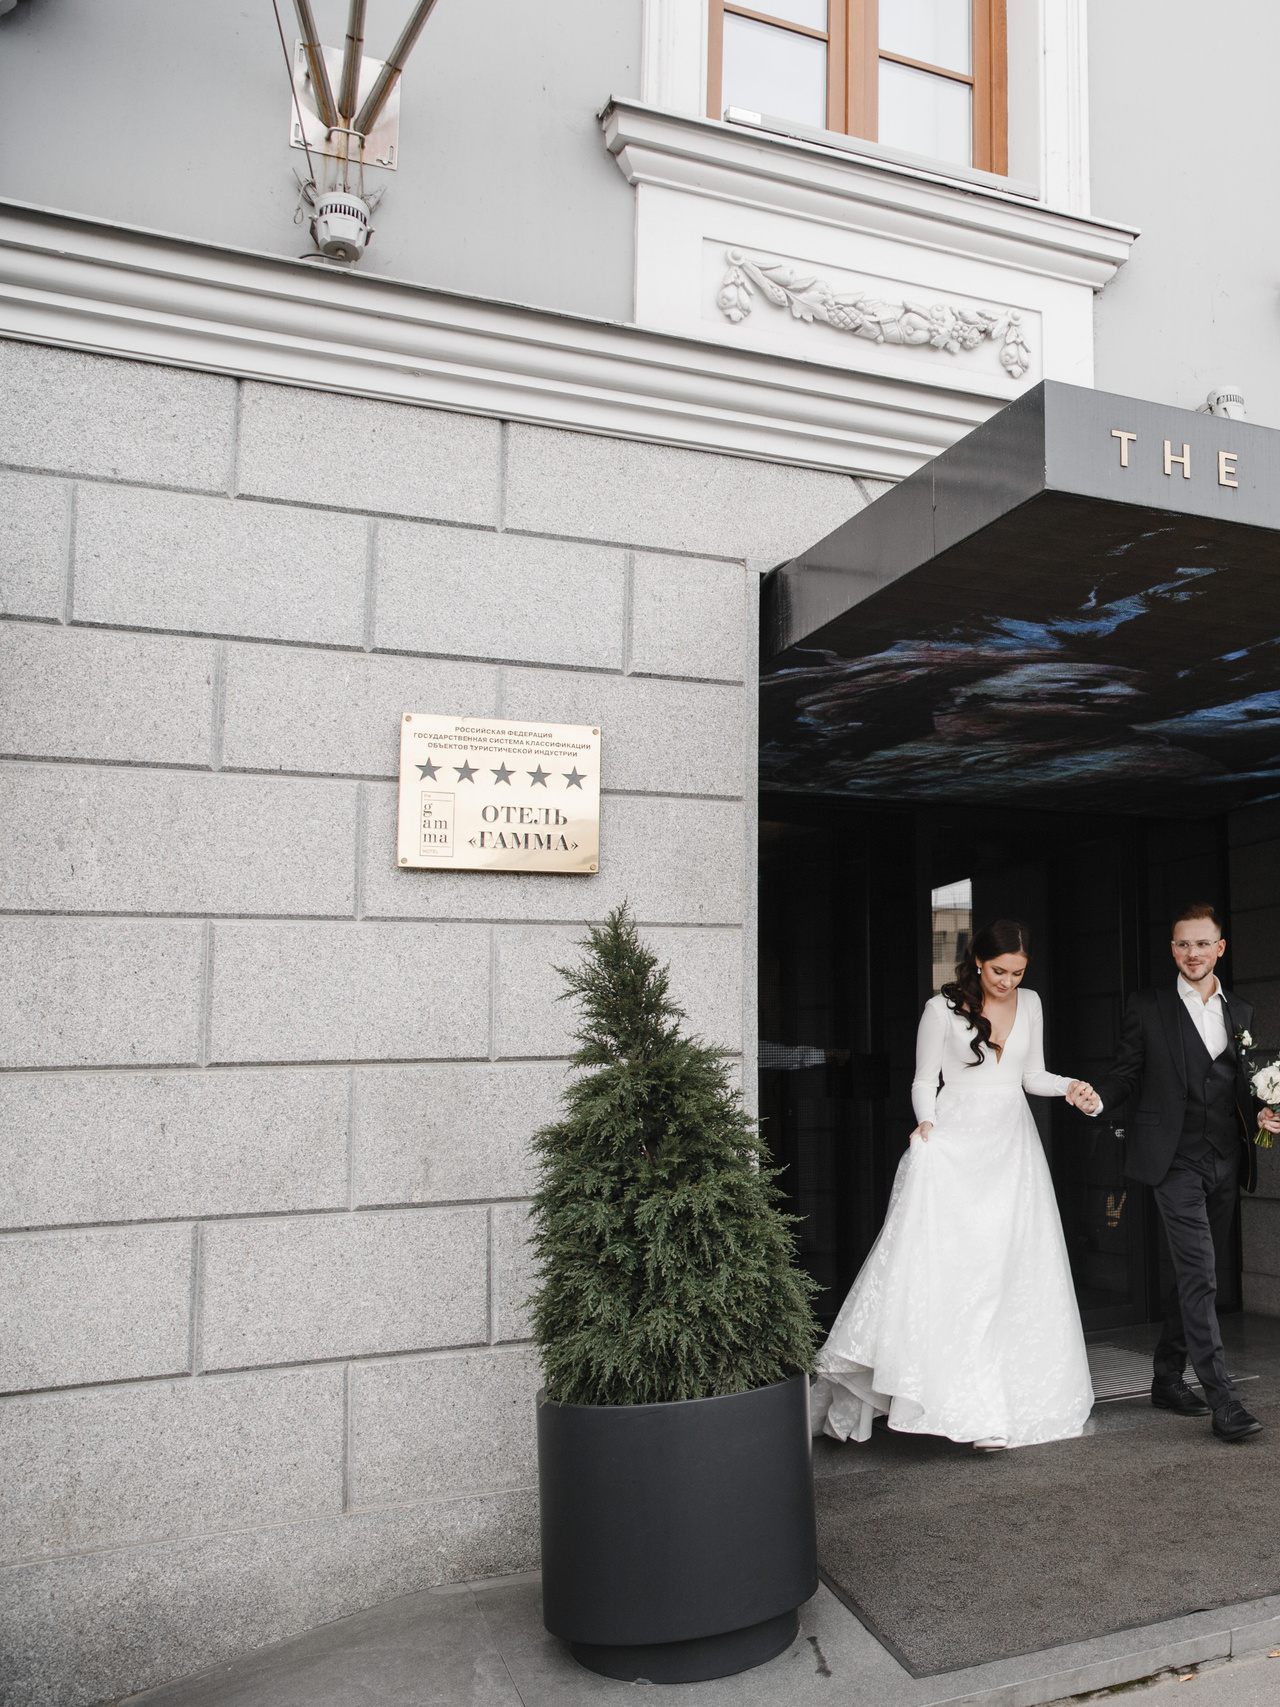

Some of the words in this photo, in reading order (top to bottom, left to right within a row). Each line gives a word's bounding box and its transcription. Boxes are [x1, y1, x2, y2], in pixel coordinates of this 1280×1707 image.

[1111, 429, 1240, 488] THE
[454, 726, 506, 736] РОССИЙСКАЯ
[507, 730, 553, 739] ФЕДЕРАЦИЯ
[413, 732, 488, 743] ГОСУДАРСТВЕННАЯ
[489, 737, 525, 746] СИСТЕМА
[525, 740, 591, 750] КЛАССИФИКАЦИИ
[427, 742, 469, 751] ОБЪЕКТОВ
[470, 744, 533, 755] ТУРИСТИЧЕСКОЙ
[534, 748, 578, 758] ИНДУСТРИИ
[422, 802, 433, 818] g
[481, 804, 568, 826] ОТЕЛЬ
[422, 819, 449, 830] am
[423, 833, 448, 843] ma
[468, 831, 579, 851] «ГАММА»
